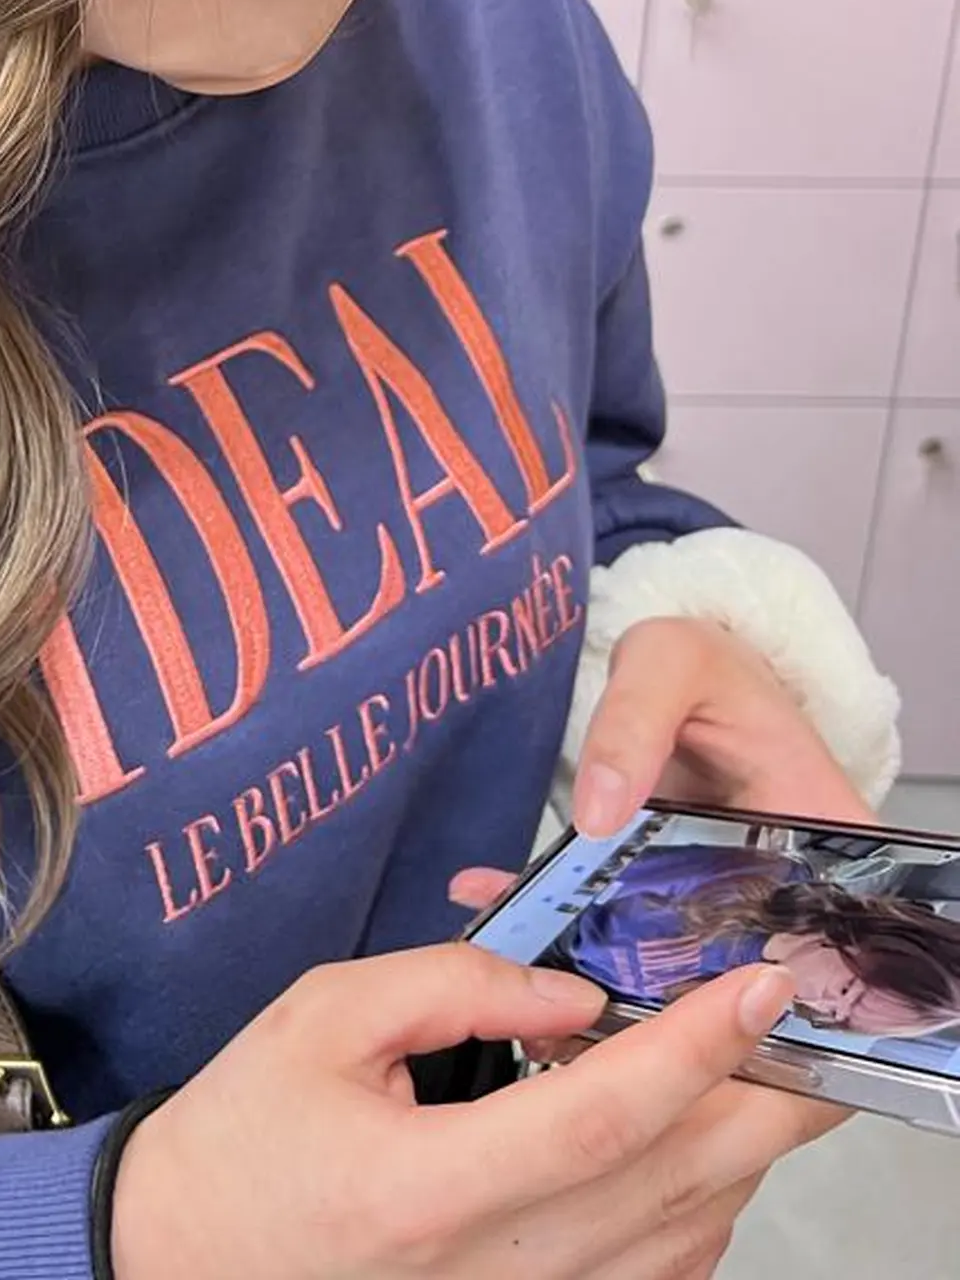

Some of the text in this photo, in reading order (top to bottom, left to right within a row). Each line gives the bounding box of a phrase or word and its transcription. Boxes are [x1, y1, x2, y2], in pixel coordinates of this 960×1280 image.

[144, 553, 582, 923] LE BELLE JOURNÉE
